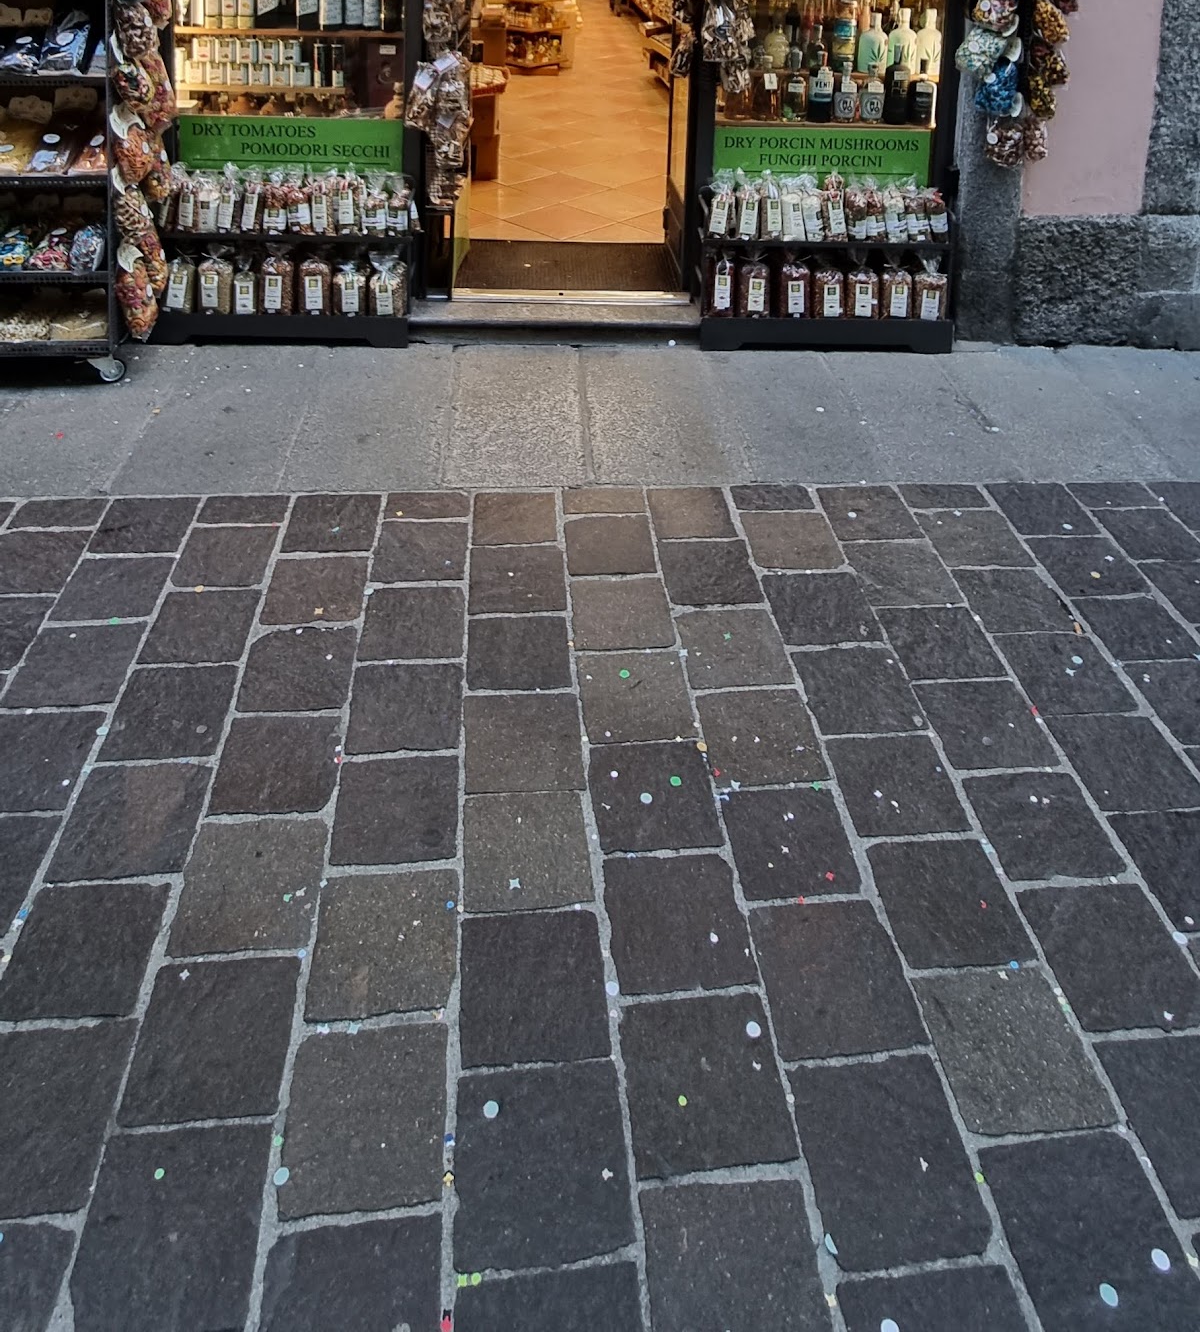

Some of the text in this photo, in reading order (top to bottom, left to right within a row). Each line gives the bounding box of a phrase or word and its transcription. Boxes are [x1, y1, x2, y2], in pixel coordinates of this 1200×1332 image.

[192, 123, 316, 139] DRY TOMATOES
[241, 142, 390, 158] POMODORI SECCHI
[724, 136, 920, 152] DRY PORCIN MUSHROOMS
[759, 153, 883, 168] FUNGHI PORCINI
